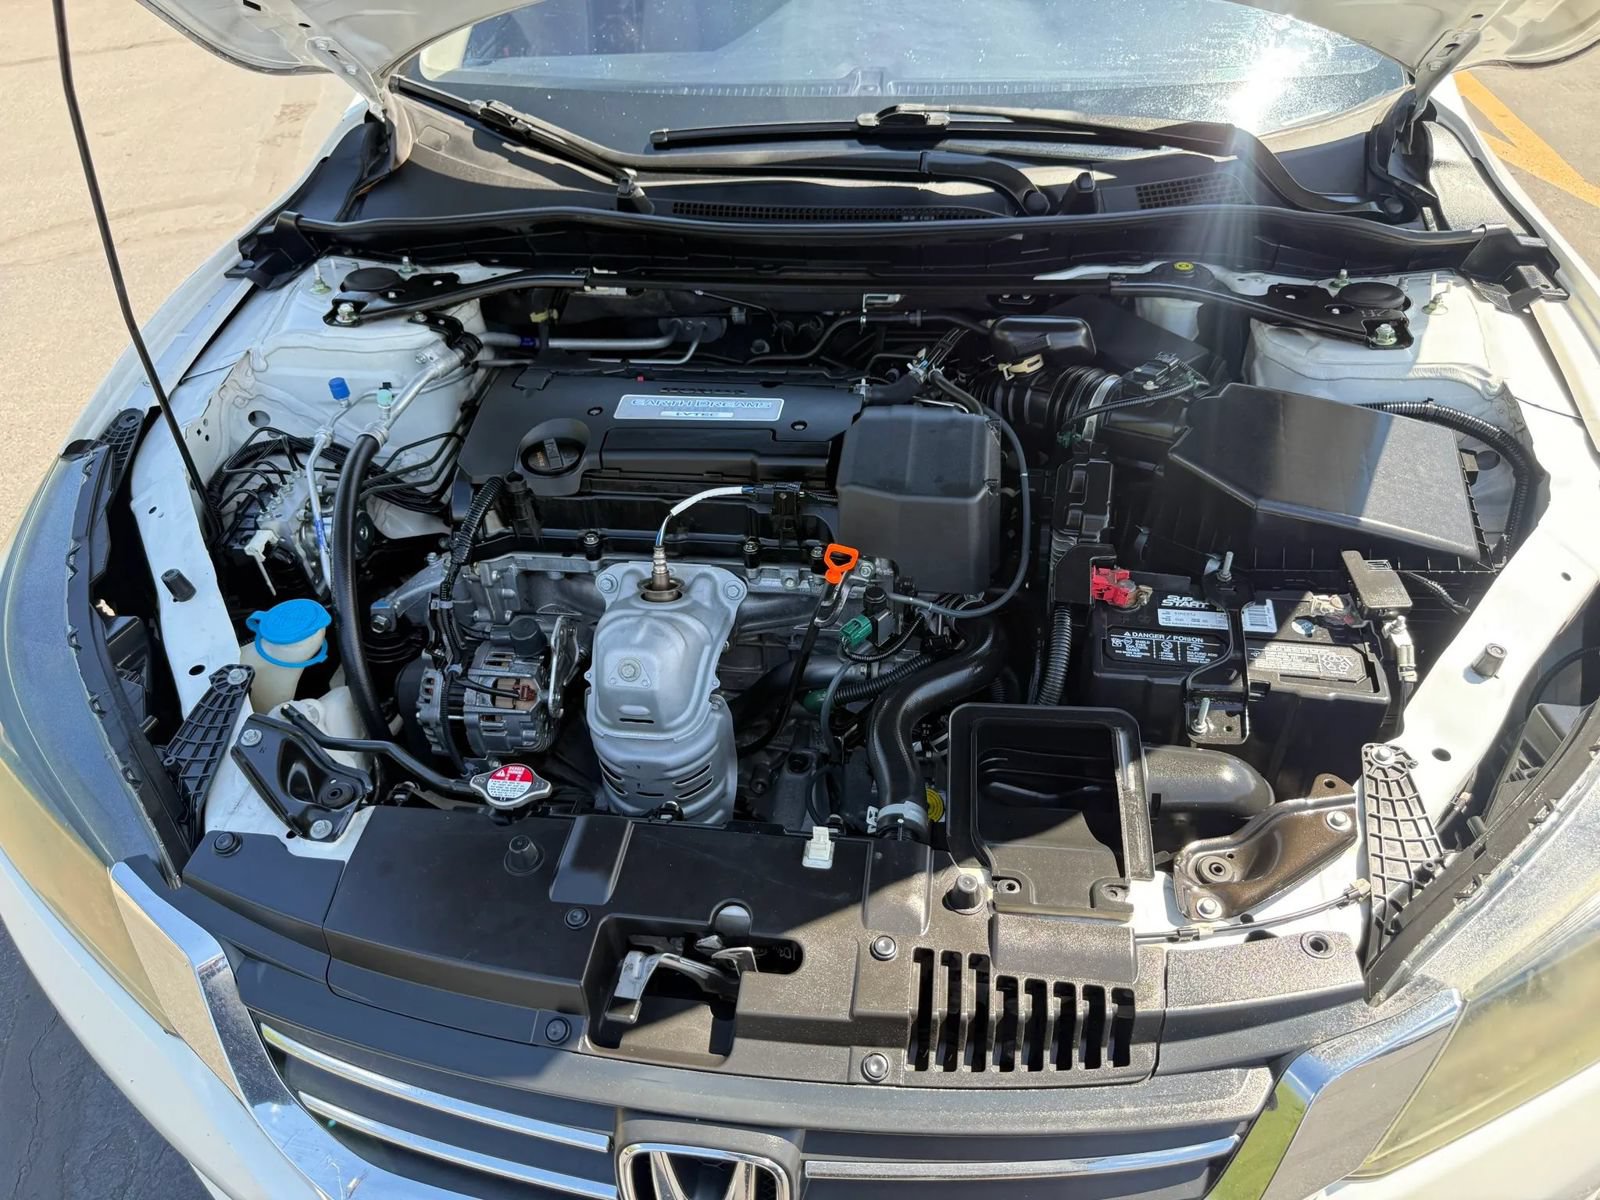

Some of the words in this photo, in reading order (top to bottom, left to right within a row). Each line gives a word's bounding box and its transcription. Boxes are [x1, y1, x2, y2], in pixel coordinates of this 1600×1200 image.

[631, 399, 692, 407] EARTH
[694, 400, 773, 409] DREAMS
[1132, 632, 1165, 640] DANGER
[1173, 635, 1204, 643] POISON
